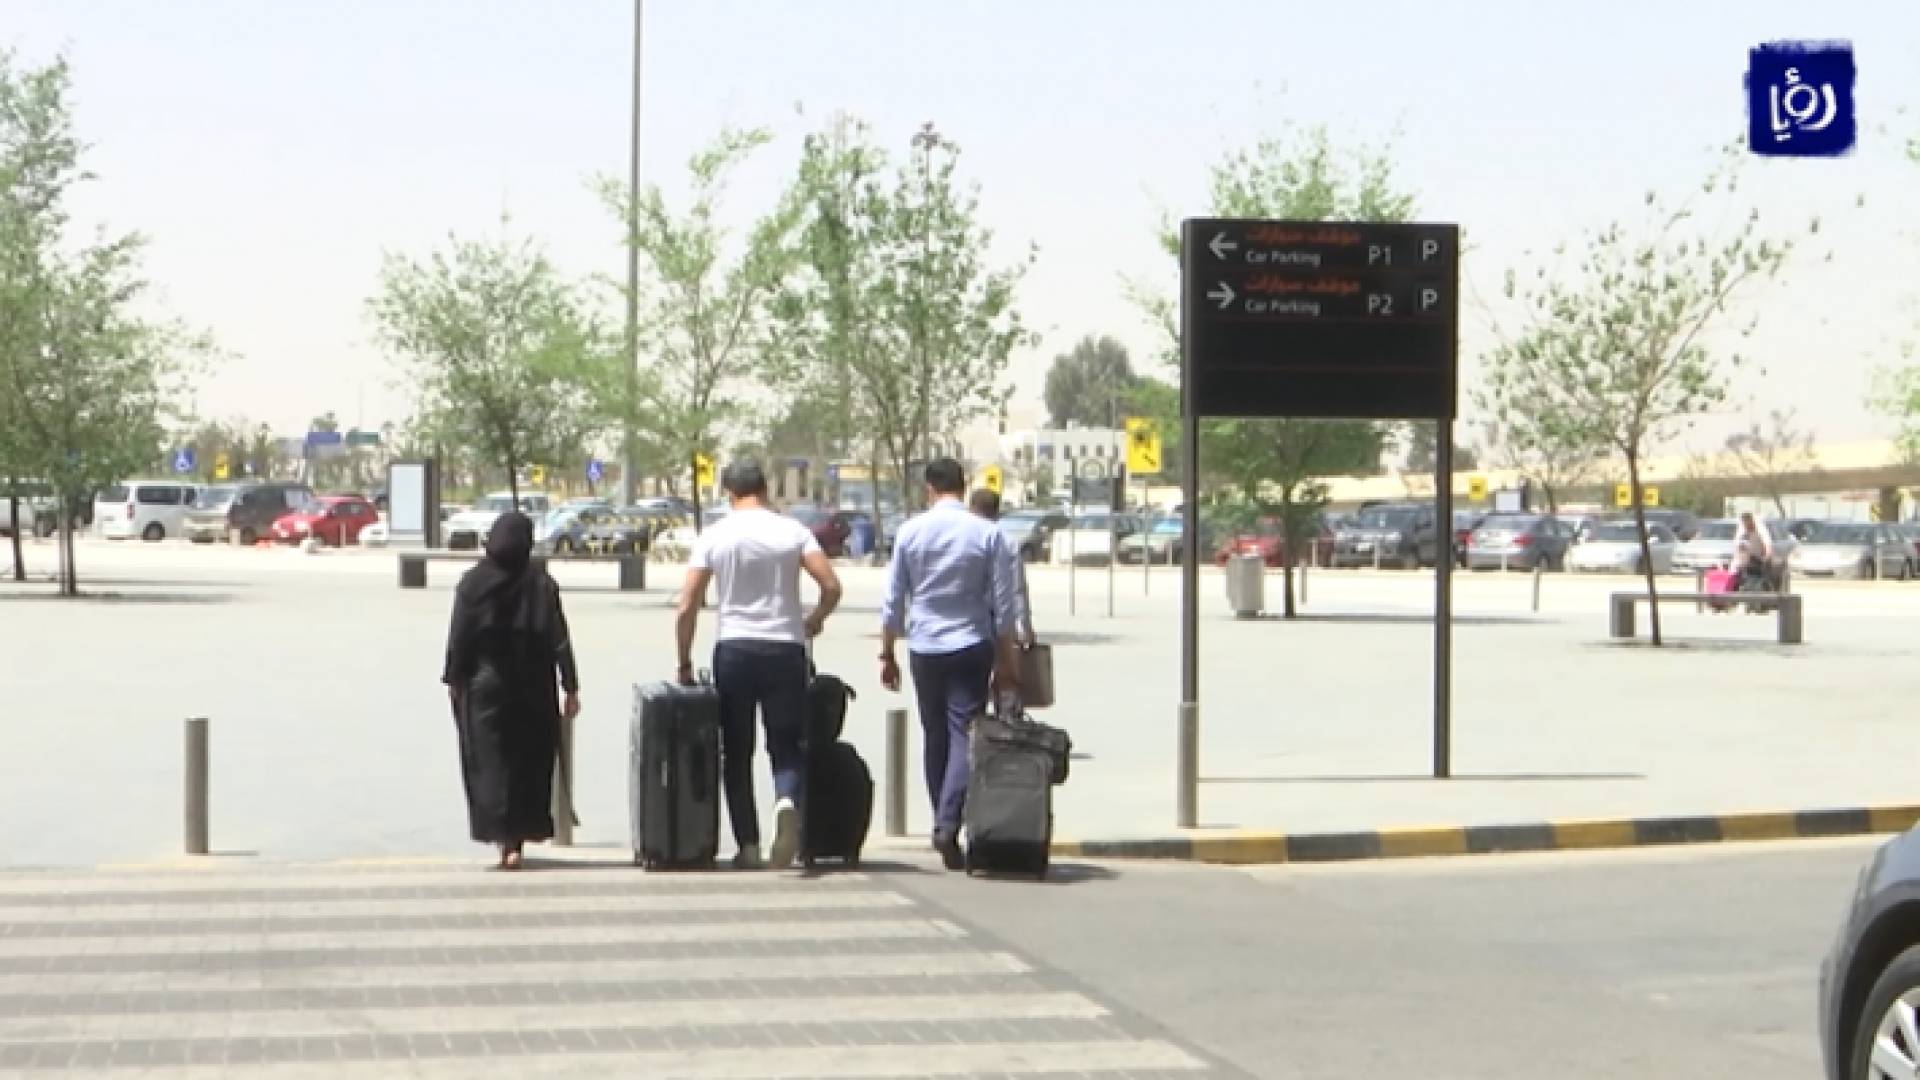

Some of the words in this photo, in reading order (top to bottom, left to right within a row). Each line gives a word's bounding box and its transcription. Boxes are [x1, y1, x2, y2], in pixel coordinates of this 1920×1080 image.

[1244, 248, 1268, 264] Car
[1271, 250, 1322, 269] Parking
[1368, 245, 1392, 266] P1
[1421, 239, 1439, 262] P
[1244, 298, 1268, 313] Car
[1271, 299, 1322, 318] Parking
[1368, 294, 1393, 315] P2
[1421, 288, 1439, 311] P
